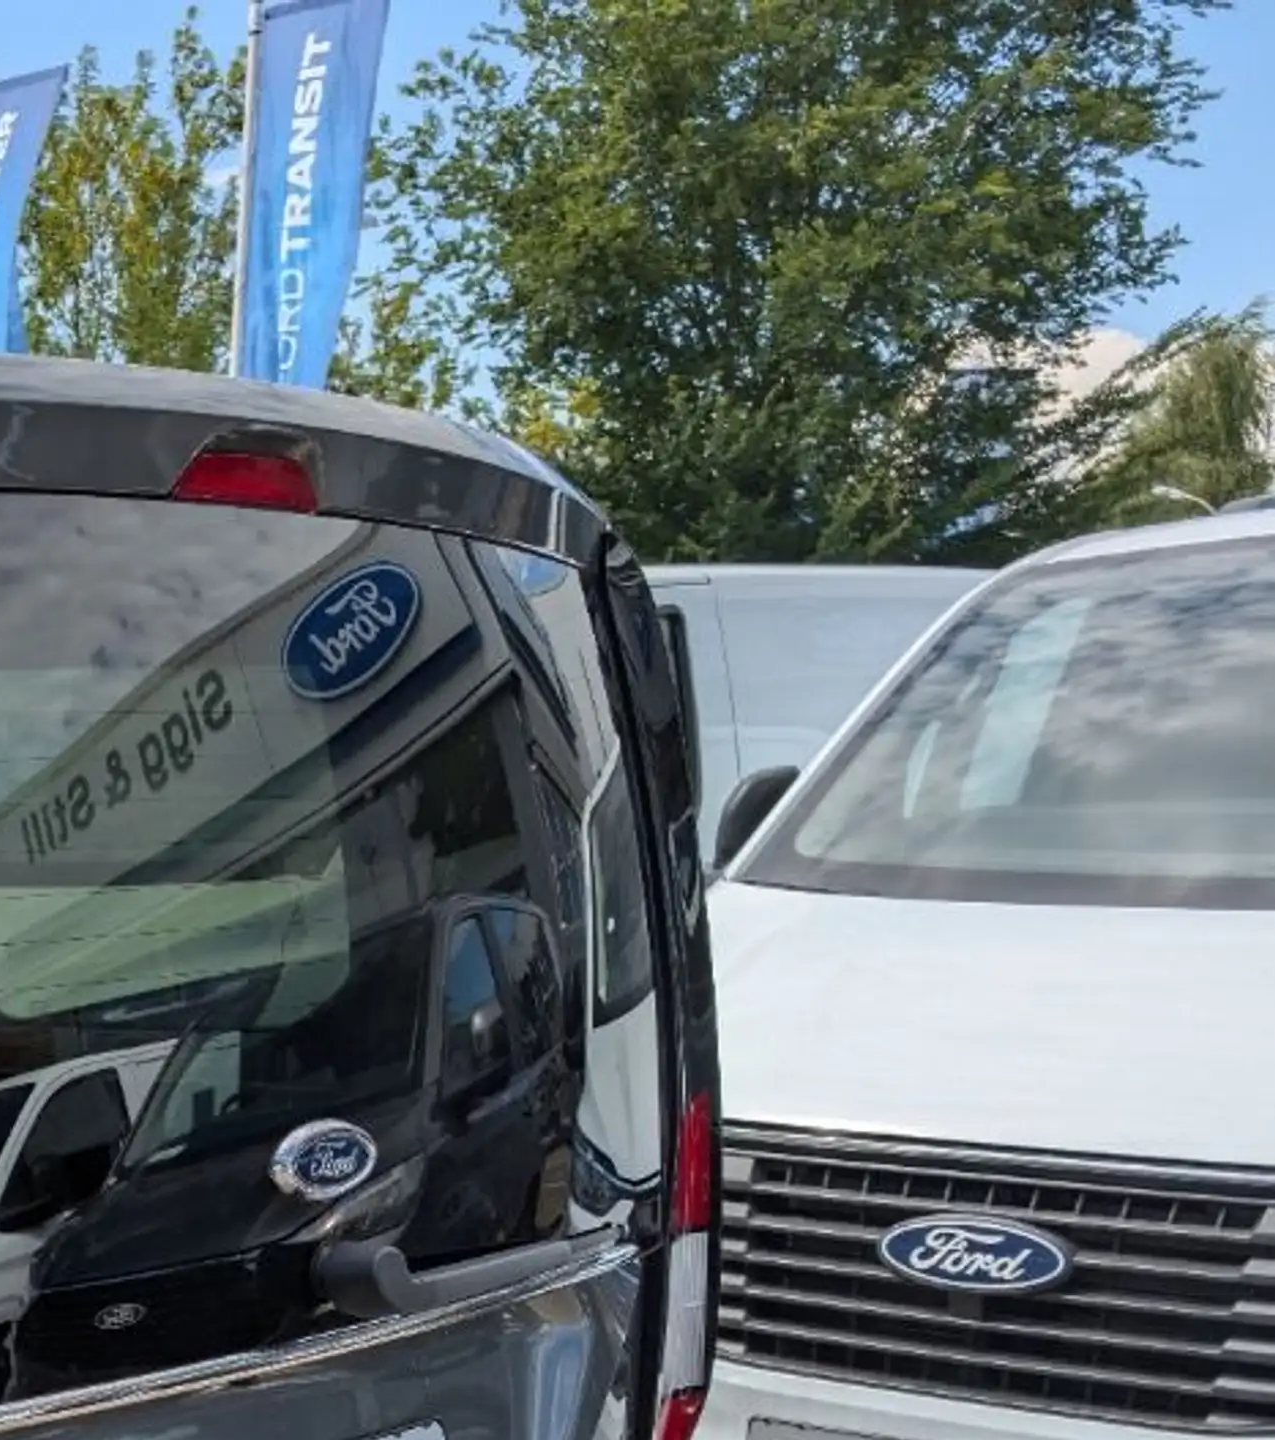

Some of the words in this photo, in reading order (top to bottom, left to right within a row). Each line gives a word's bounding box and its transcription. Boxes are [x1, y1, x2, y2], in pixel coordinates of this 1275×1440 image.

[280, 31, 332, 263] TRANSIT
[277, 268, 305, 383] ORD
[908, 1227, 1034, 1281] Ford
